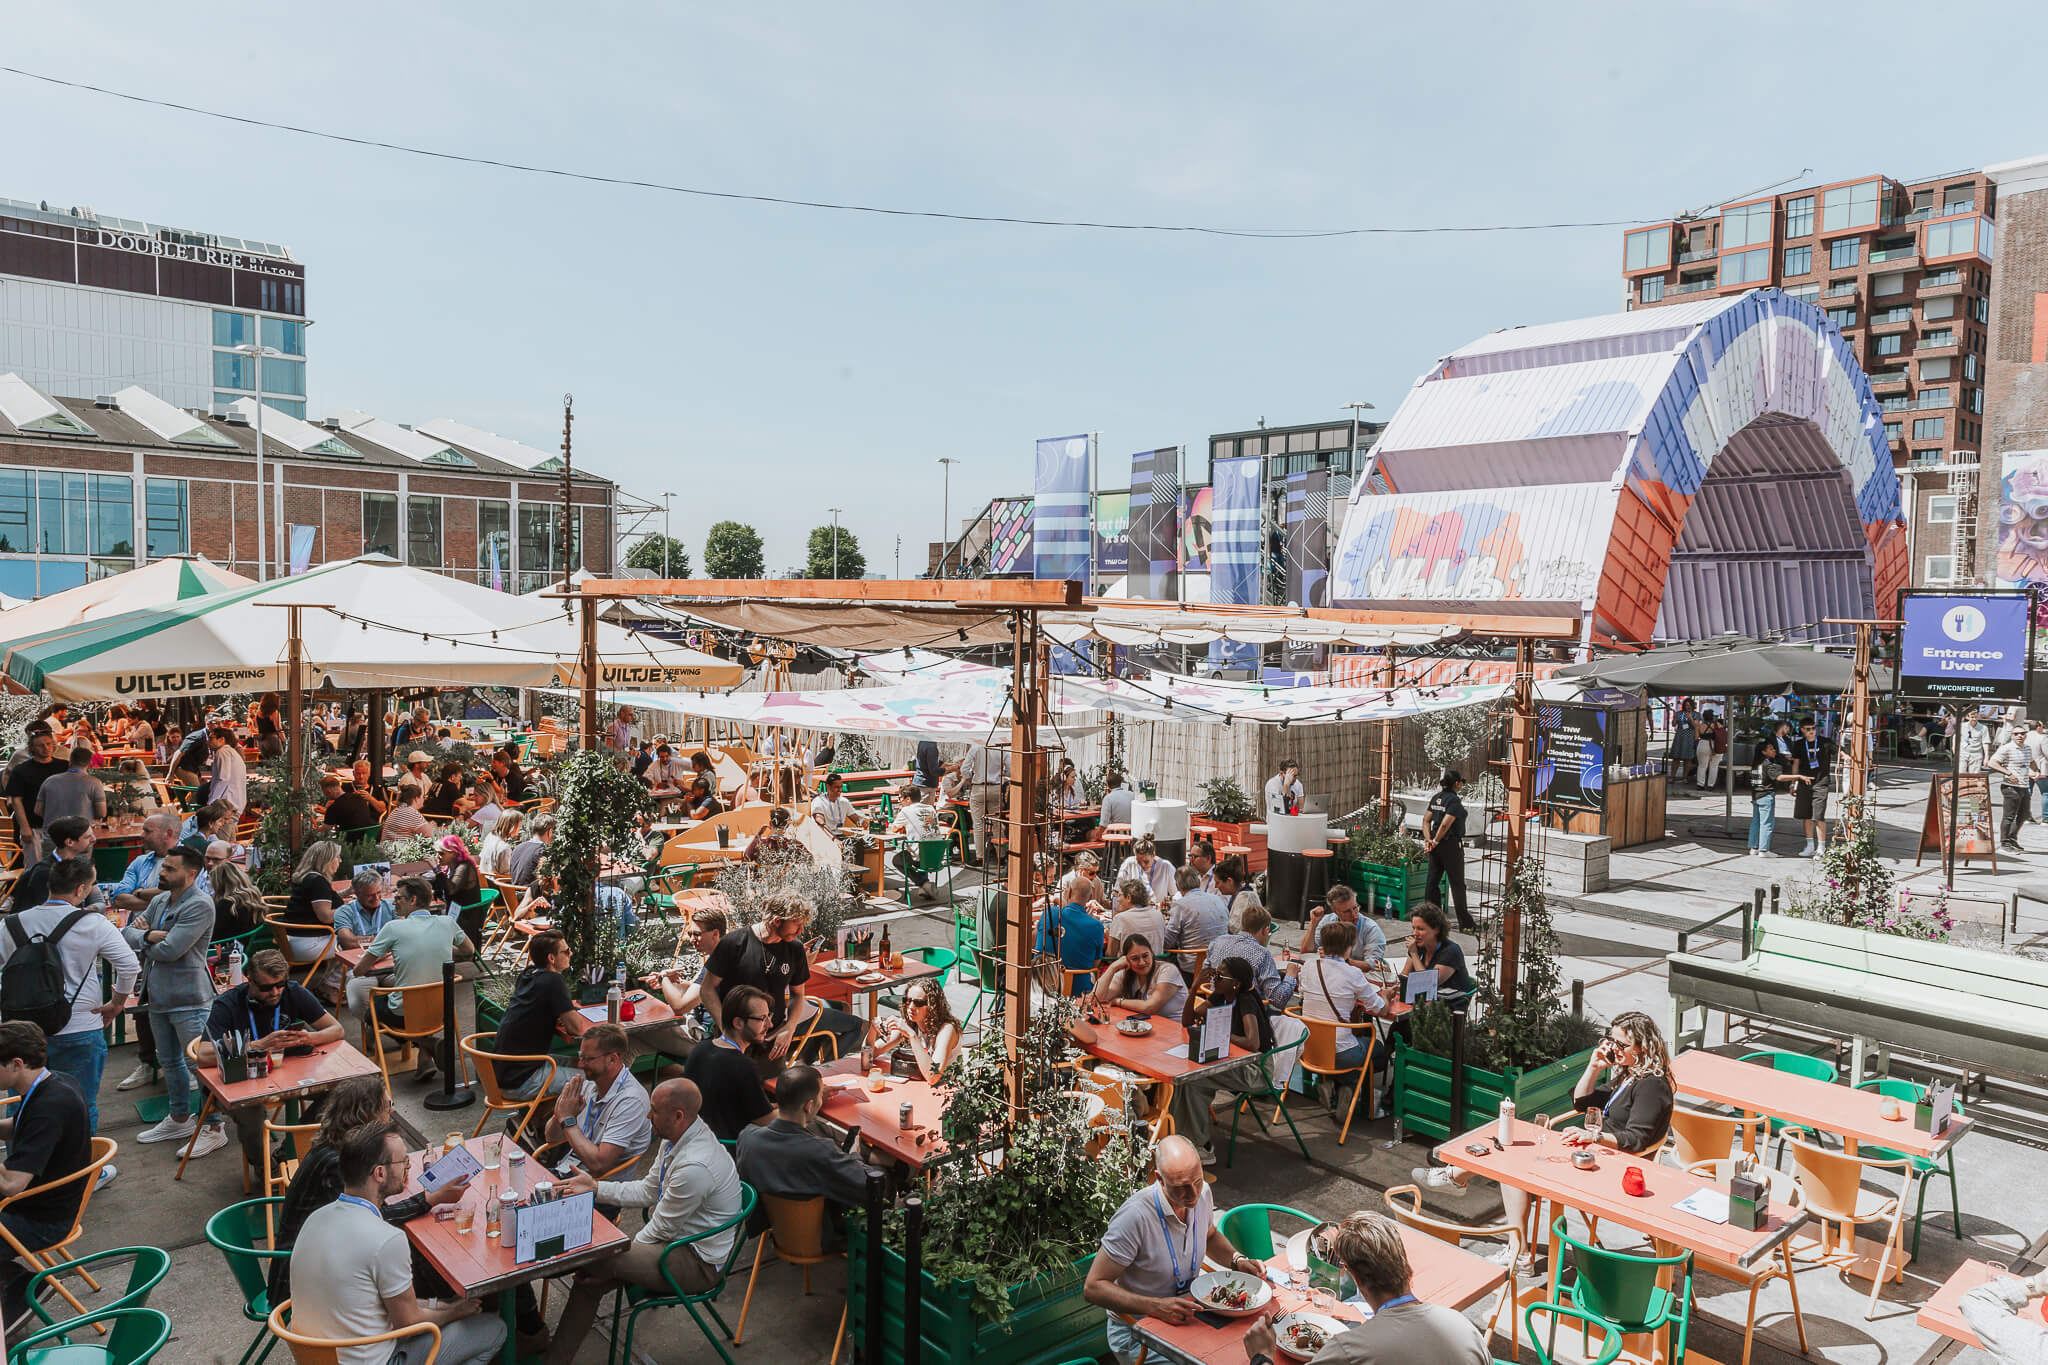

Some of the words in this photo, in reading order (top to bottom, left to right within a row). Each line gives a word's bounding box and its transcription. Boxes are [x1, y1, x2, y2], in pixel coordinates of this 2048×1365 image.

[249, 263, 295, 276] HILTON
[1923, 647, 2004, 660] Entrance
[115, 672, 206, 694] UILTJE
[209, 669, 265, 680] BREWING
[602, 667, 662, 683] UILTJE
[1927, 684, 1996, 694] #TNWCONFERENCE
[1550, 732, 1573, 741] Happy
[1574, 734, 1593, 742] Hour
[1546, 749, 1574, 758] Closing
[1574, 751, 1595, 761] Party
